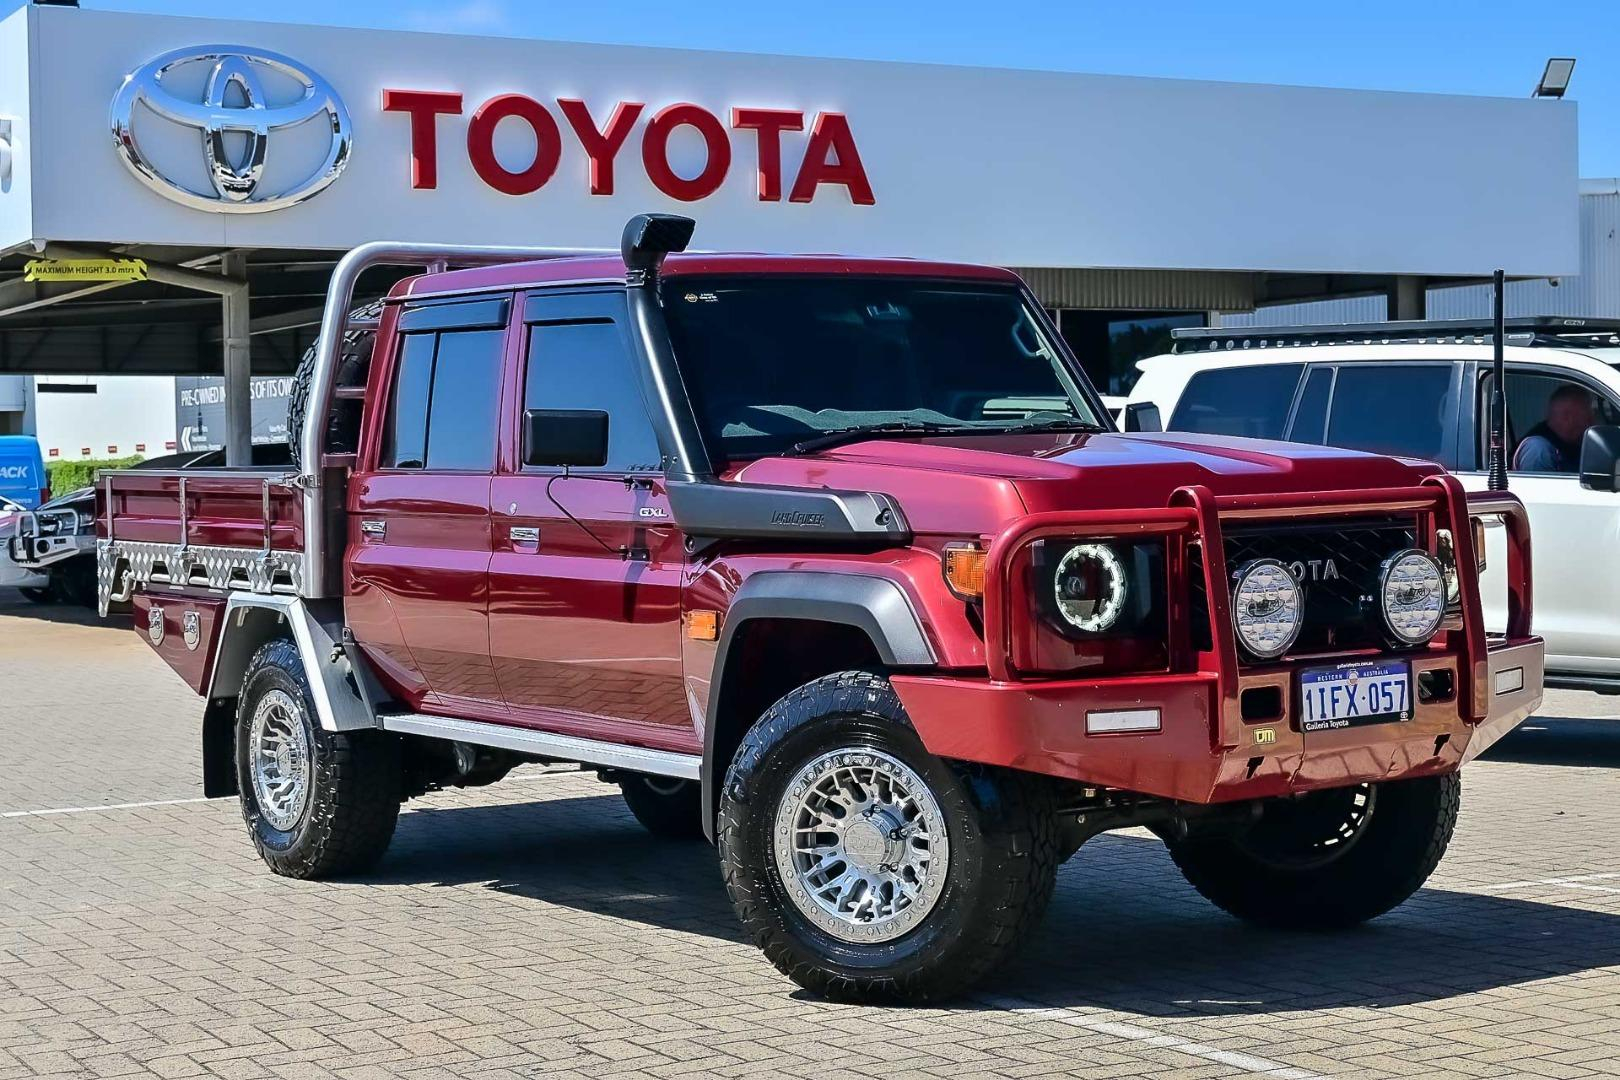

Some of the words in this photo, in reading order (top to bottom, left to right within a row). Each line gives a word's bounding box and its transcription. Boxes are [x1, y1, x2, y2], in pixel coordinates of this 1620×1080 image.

[382, 88, 876, 206] TOYOTA
[181, 387, 219, 406] PRE-OWNED
[255, 381, 266, 399] OF
[266, 379, 277, 398] ITS
[639, 507, 668, 518] GXL
[1289, 559, 1340, 581] OTA
[1317, 674, 1343, 682] WESTERN
[1305, 722, 1329, 731] Galleria
[1329, 719, 1350, 728] Toyota
